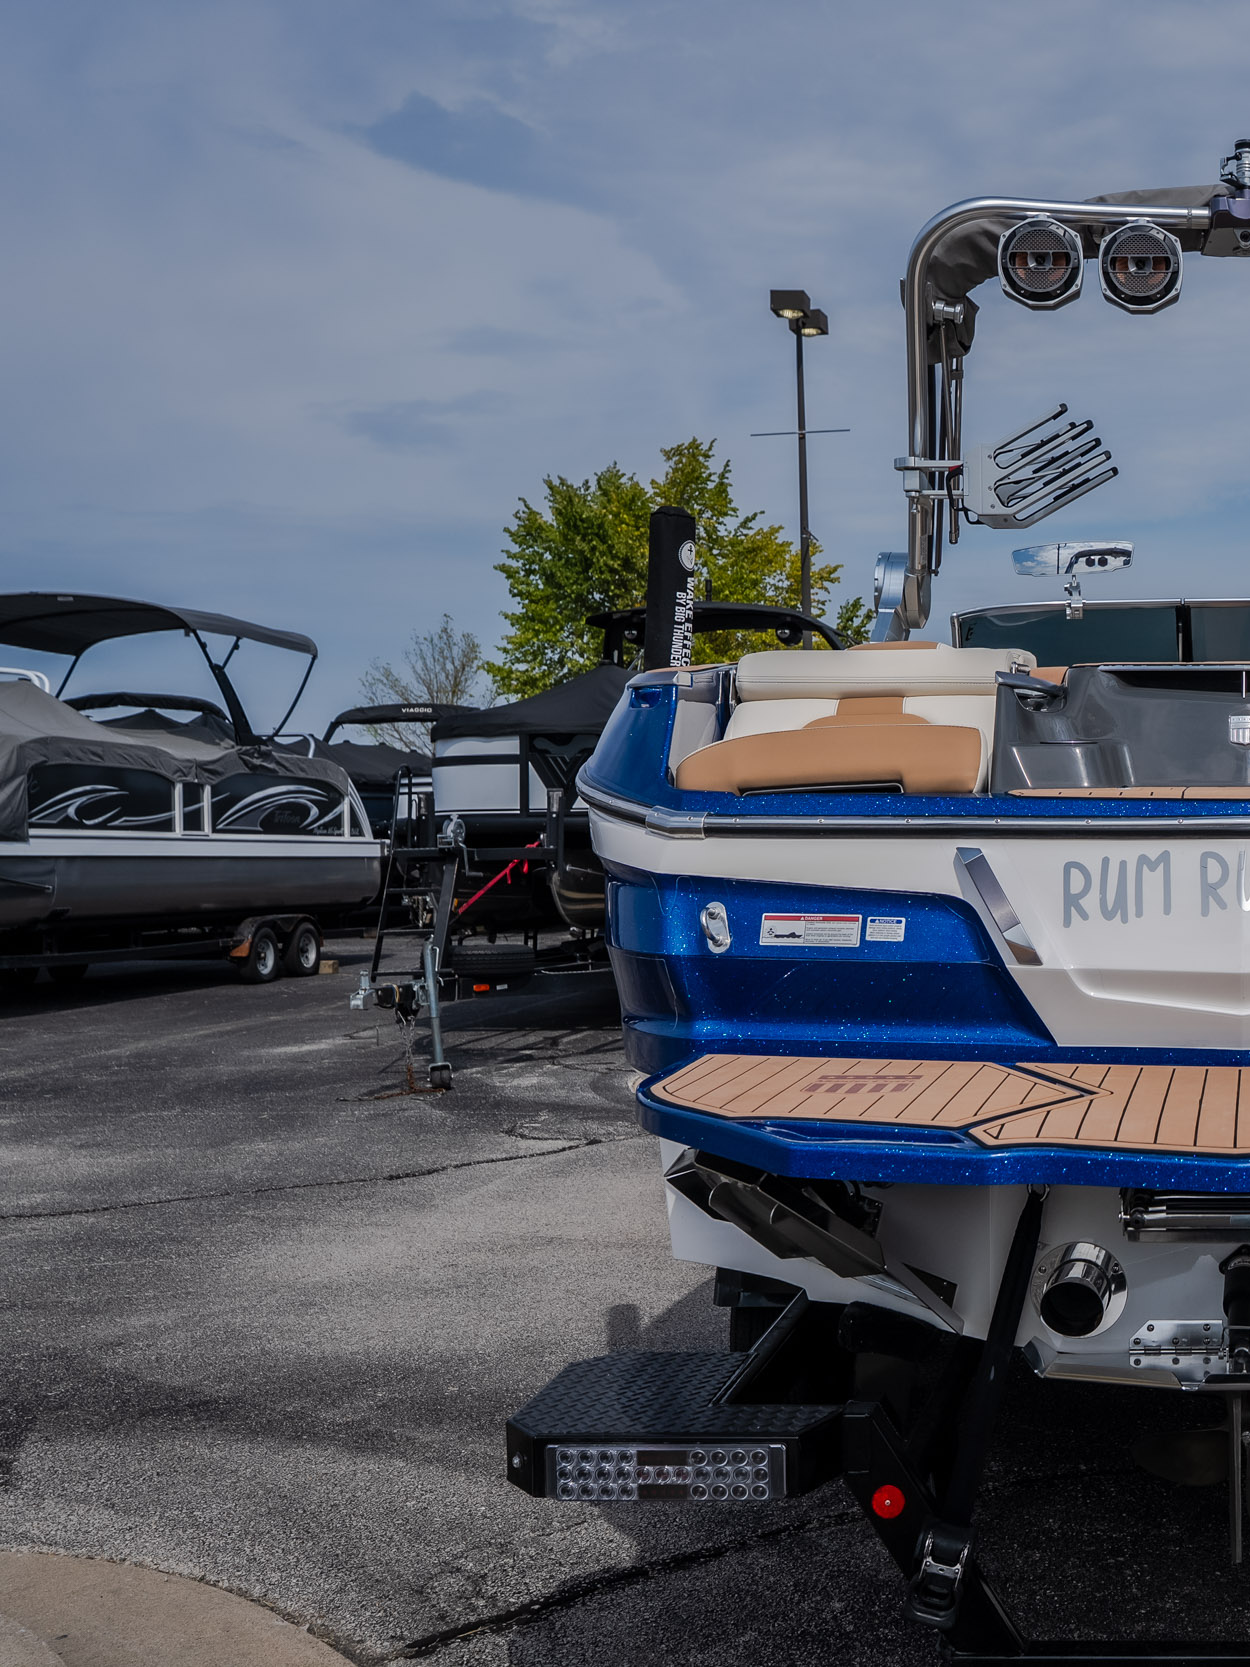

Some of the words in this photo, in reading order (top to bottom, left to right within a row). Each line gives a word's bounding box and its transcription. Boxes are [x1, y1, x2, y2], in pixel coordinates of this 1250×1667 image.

[674, 605, 686, 623] BIG
[675, 591, 687, 605] BY
[685, 577, 695, 619] WAKE
[670, 623, 685, 667] THUNDER
[1063, 850, 1171, 929] RUM
